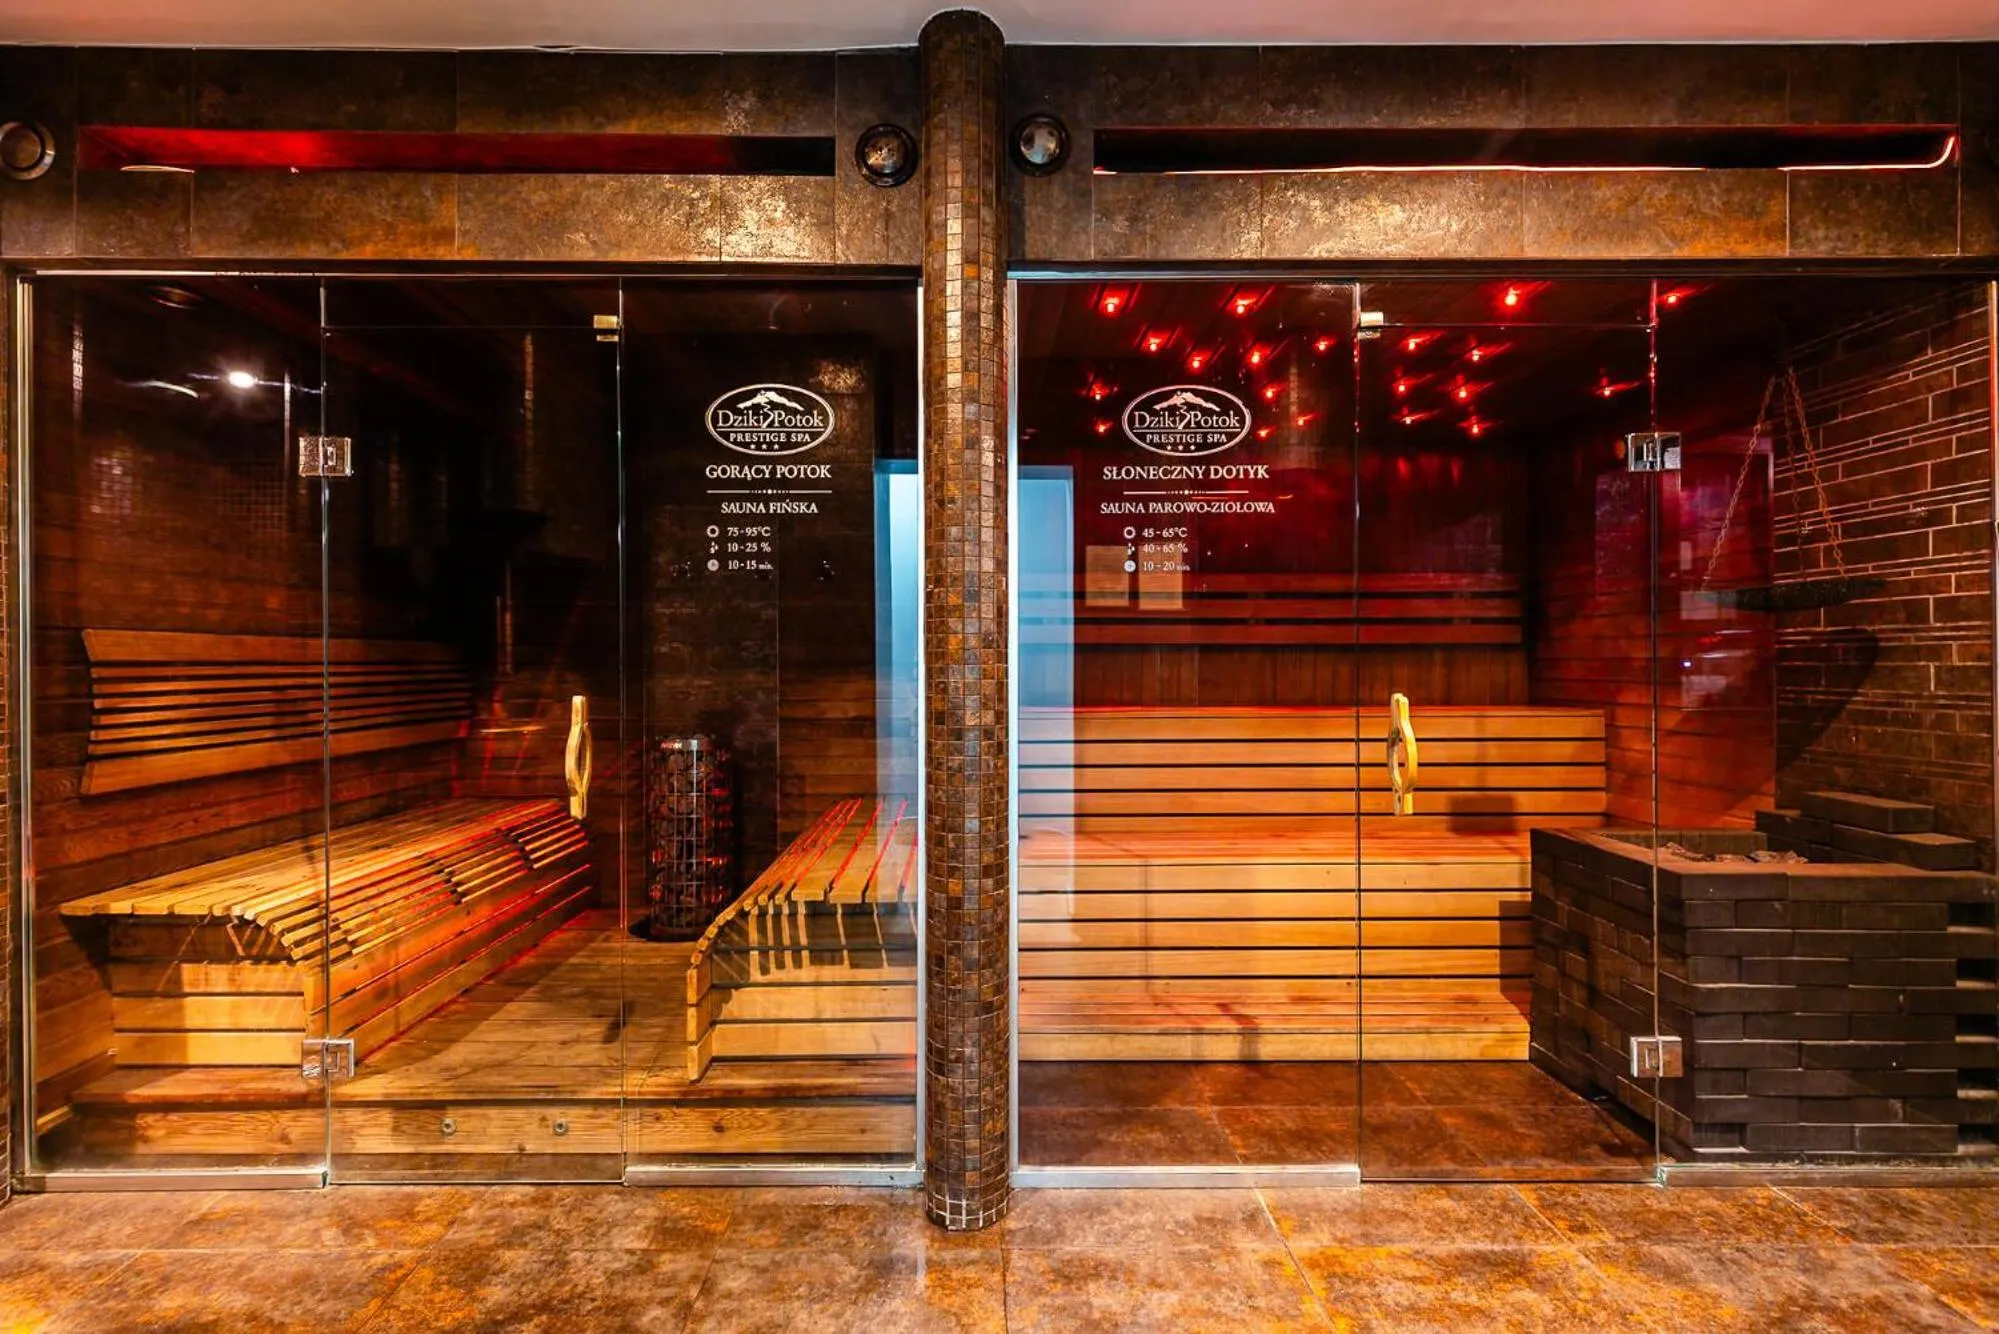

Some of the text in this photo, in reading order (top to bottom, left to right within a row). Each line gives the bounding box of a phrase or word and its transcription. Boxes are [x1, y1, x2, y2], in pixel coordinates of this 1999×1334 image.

[716, 409, 824, 427] Dziki Potok
[1133, 410, 1241, 428] Dziki Potok
[729, 432, 811, 442] PRESTIGE SPA
[1146, 433, 1228, 443] PRESTIGE SPA
[705, 464, 832, 480] GORĄCY POTOK
[1209, 465, 1269, 479] DOTYK
[720, 499, 819, 514] SAUNA FIŃSKA
[1100, 502, 1146, 514] SAUNA
